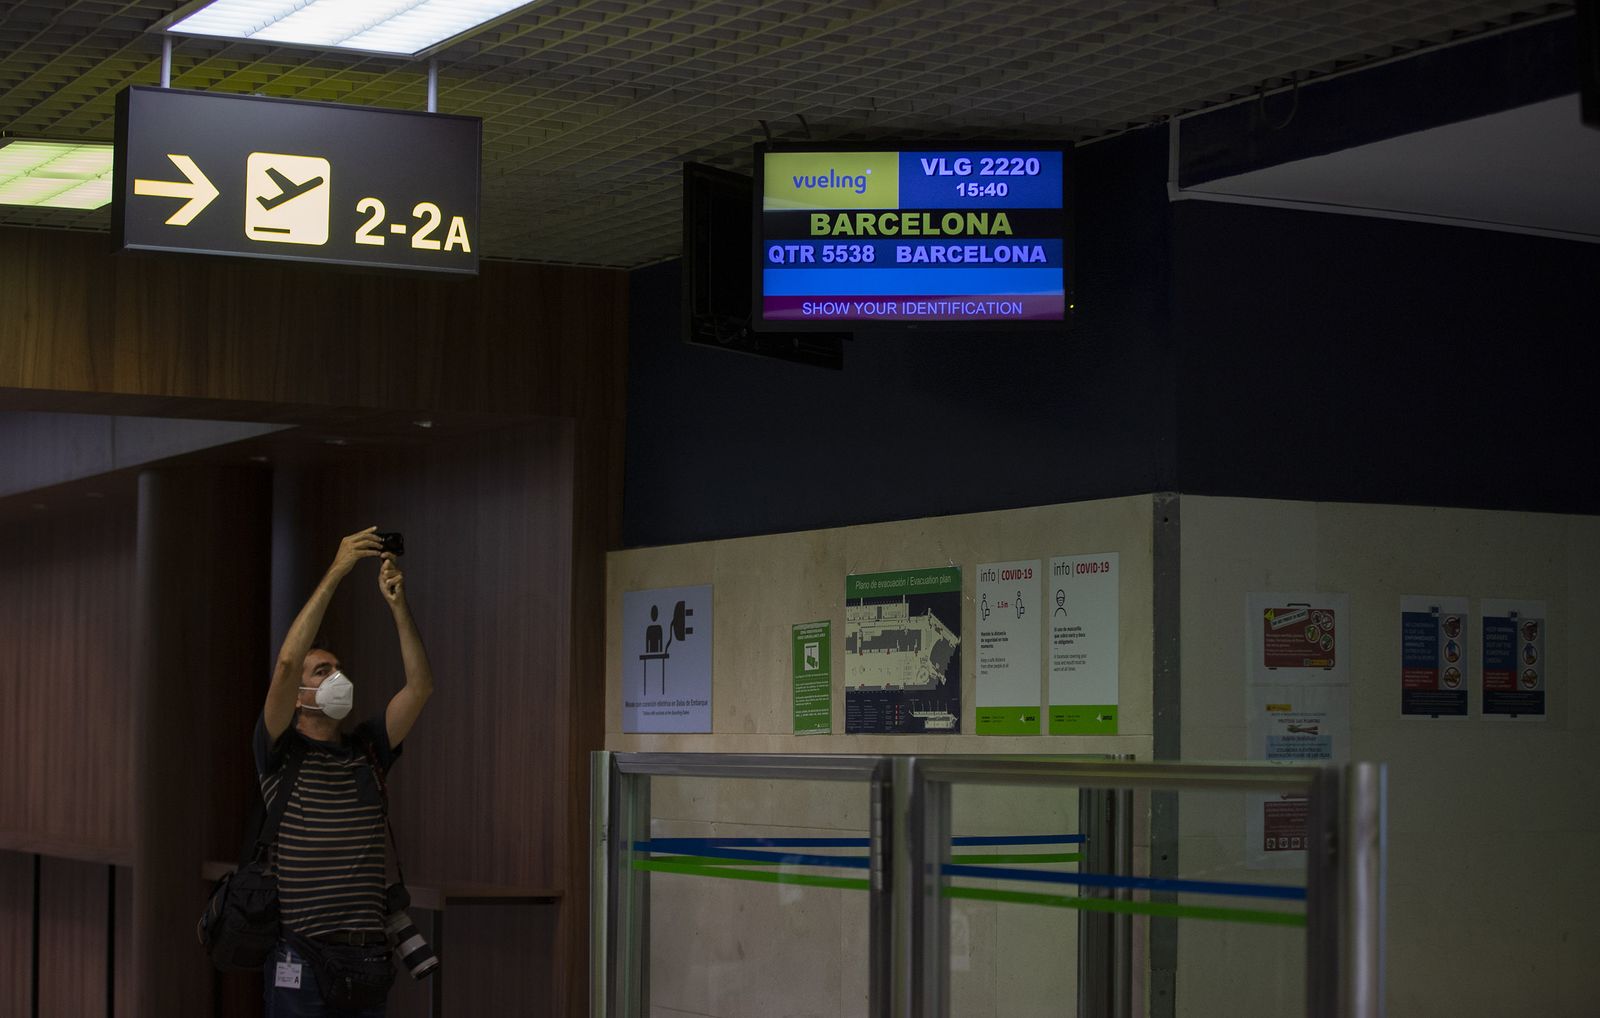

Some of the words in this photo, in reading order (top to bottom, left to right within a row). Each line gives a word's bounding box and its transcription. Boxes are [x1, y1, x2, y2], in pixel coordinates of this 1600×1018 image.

[921, 158, 972, 176] VLG
[980, 158, 1040, 176] 2220
[793, 168, 871, 194] vueling
[956, 182, 1008, 197] 15:40
[355, 197, 471, 253] 2-2A
[811, 212, 1013, 236] BARCELONA
[769, 244, 816, 264] QTR
[822, 244, 875, 263] 5538
[896, 245, 1047, 263] BARCELONA
[802, 301, 850, 315] SHOW
[854, 301, 897, 315] YOUR
[902, 301, 1023, 315] IDENTIFICATION
[980, 569, 996, 582] info
[1002, 567, 1033, 580] COVID-19
[1054, 562, 1070, 576] info
[1076, 561, 1110, 574] COVID-19
[855, 580, 870, 590] Plano
[870, 579, 878, 588] de
[939, 574, 952, 584] plan
[295, 976, 299, 984] A
